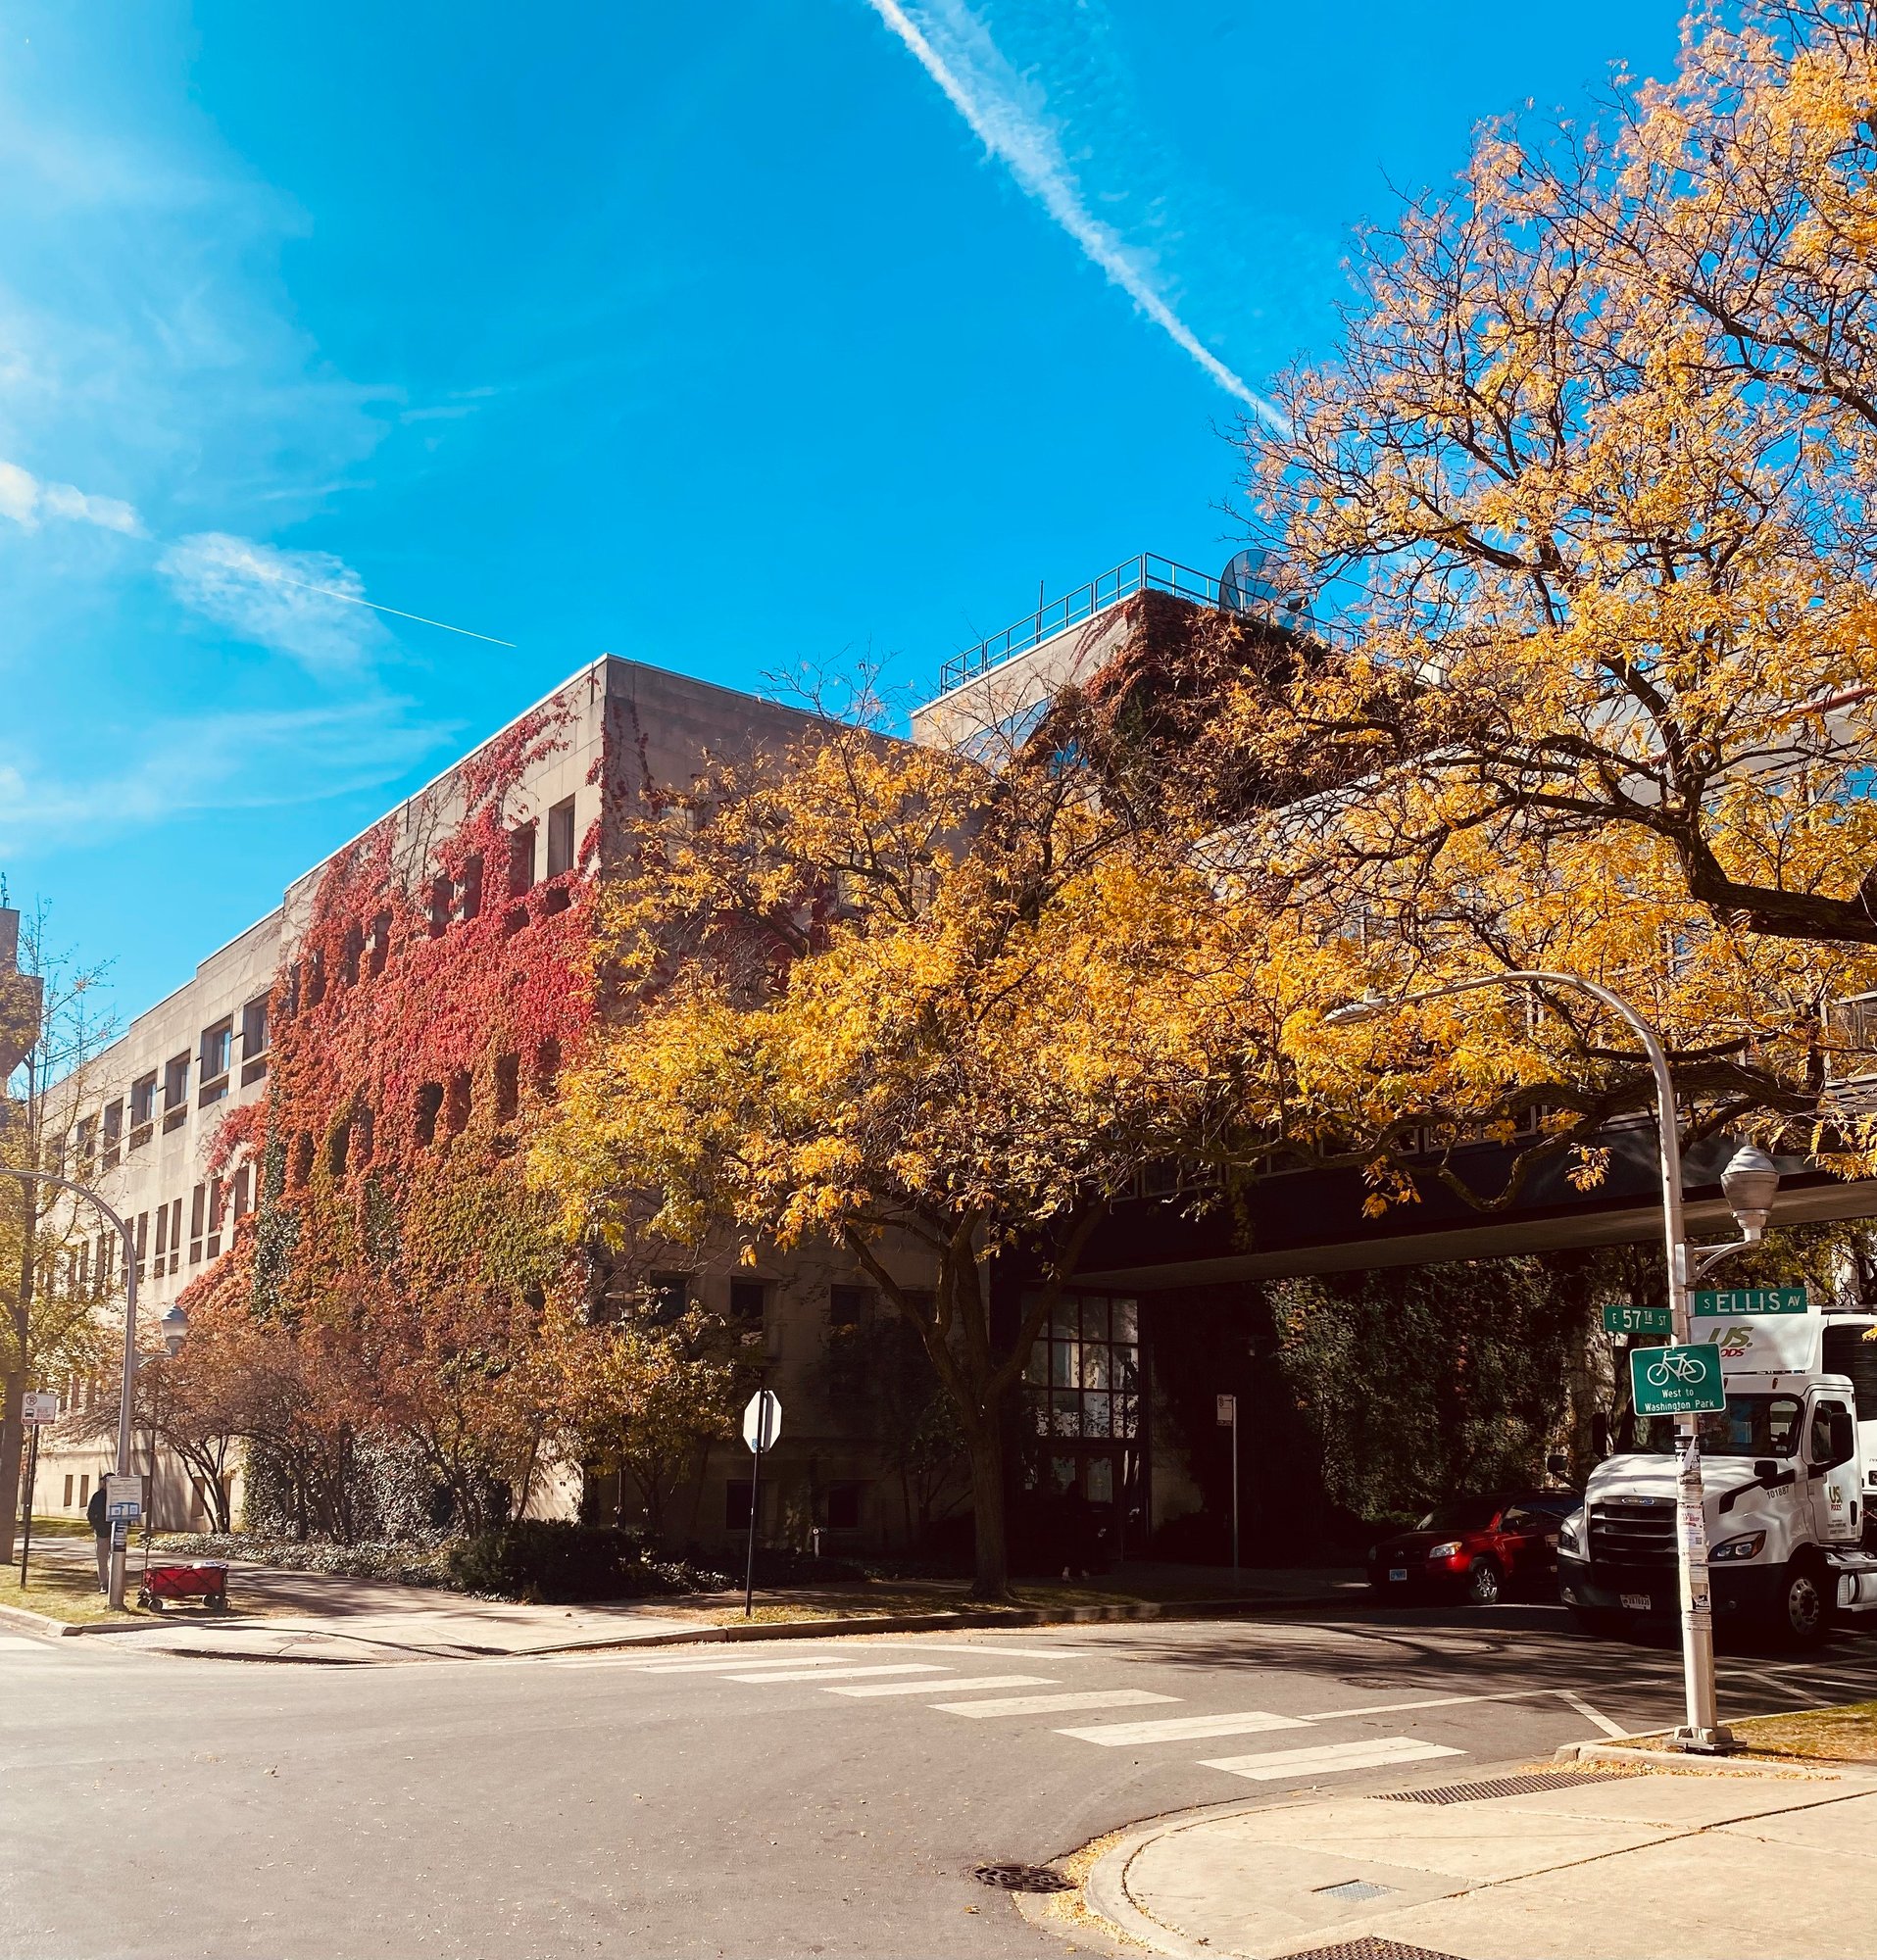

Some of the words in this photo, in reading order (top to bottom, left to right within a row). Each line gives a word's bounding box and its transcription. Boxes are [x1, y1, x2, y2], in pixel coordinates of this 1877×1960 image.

[1704, 1298, 1710, 1309] S
[1716, 1292, 1781, 1312] ELLIS
[1787, 1296, 1801, 1307] AV
[1612, 1313, 1617, 1324] E
[1622, 1309, 1654, 1329] 57TH
[1658, 1315, 1666, 1326] ST
[1721, 1348, 1746, 1357] ODS
[1661, 1389, 1681, 1398] West
[1645, 1401, 1691, 1412] Washington
[1695, 1399, 1714, 1408] Park
[1766, 1485, 1790, 1499] 101887
